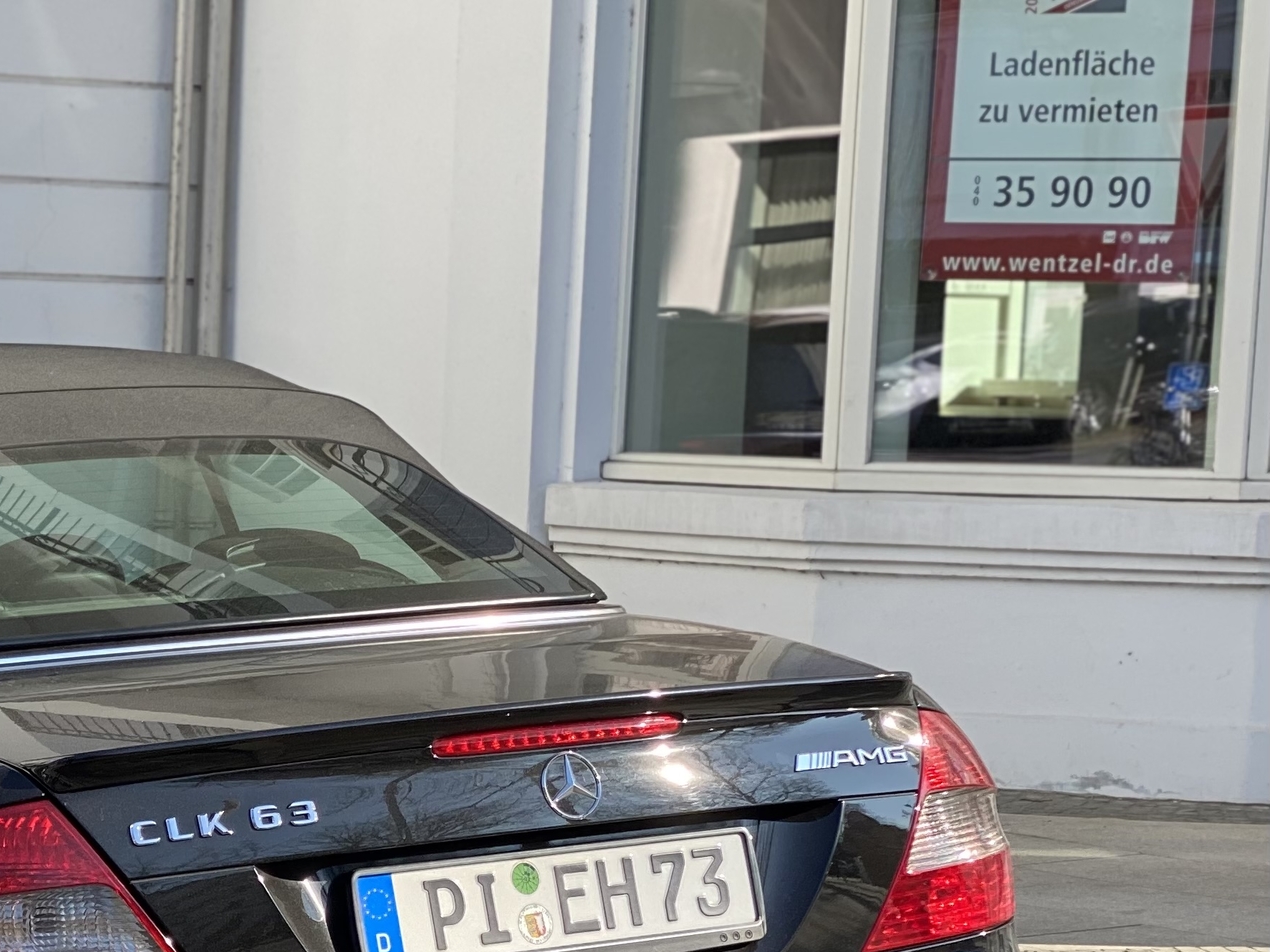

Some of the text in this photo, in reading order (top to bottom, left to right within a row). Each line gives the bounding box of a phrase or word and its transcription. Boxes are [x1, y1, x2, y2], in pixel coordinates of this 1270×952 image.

[989, 49, 1156, 77] Ladenfläche
[978, 97, 1159, 123] zu vermieten
[993, 175, 1152, 209] 35 90 90
[942, 253, 1174, 274] www.wentzel-dr.de
[831, 745, 908, 768] AMG
[129, 799, 321, 847] CLK 63
[420, 873, 513, 952] PI
